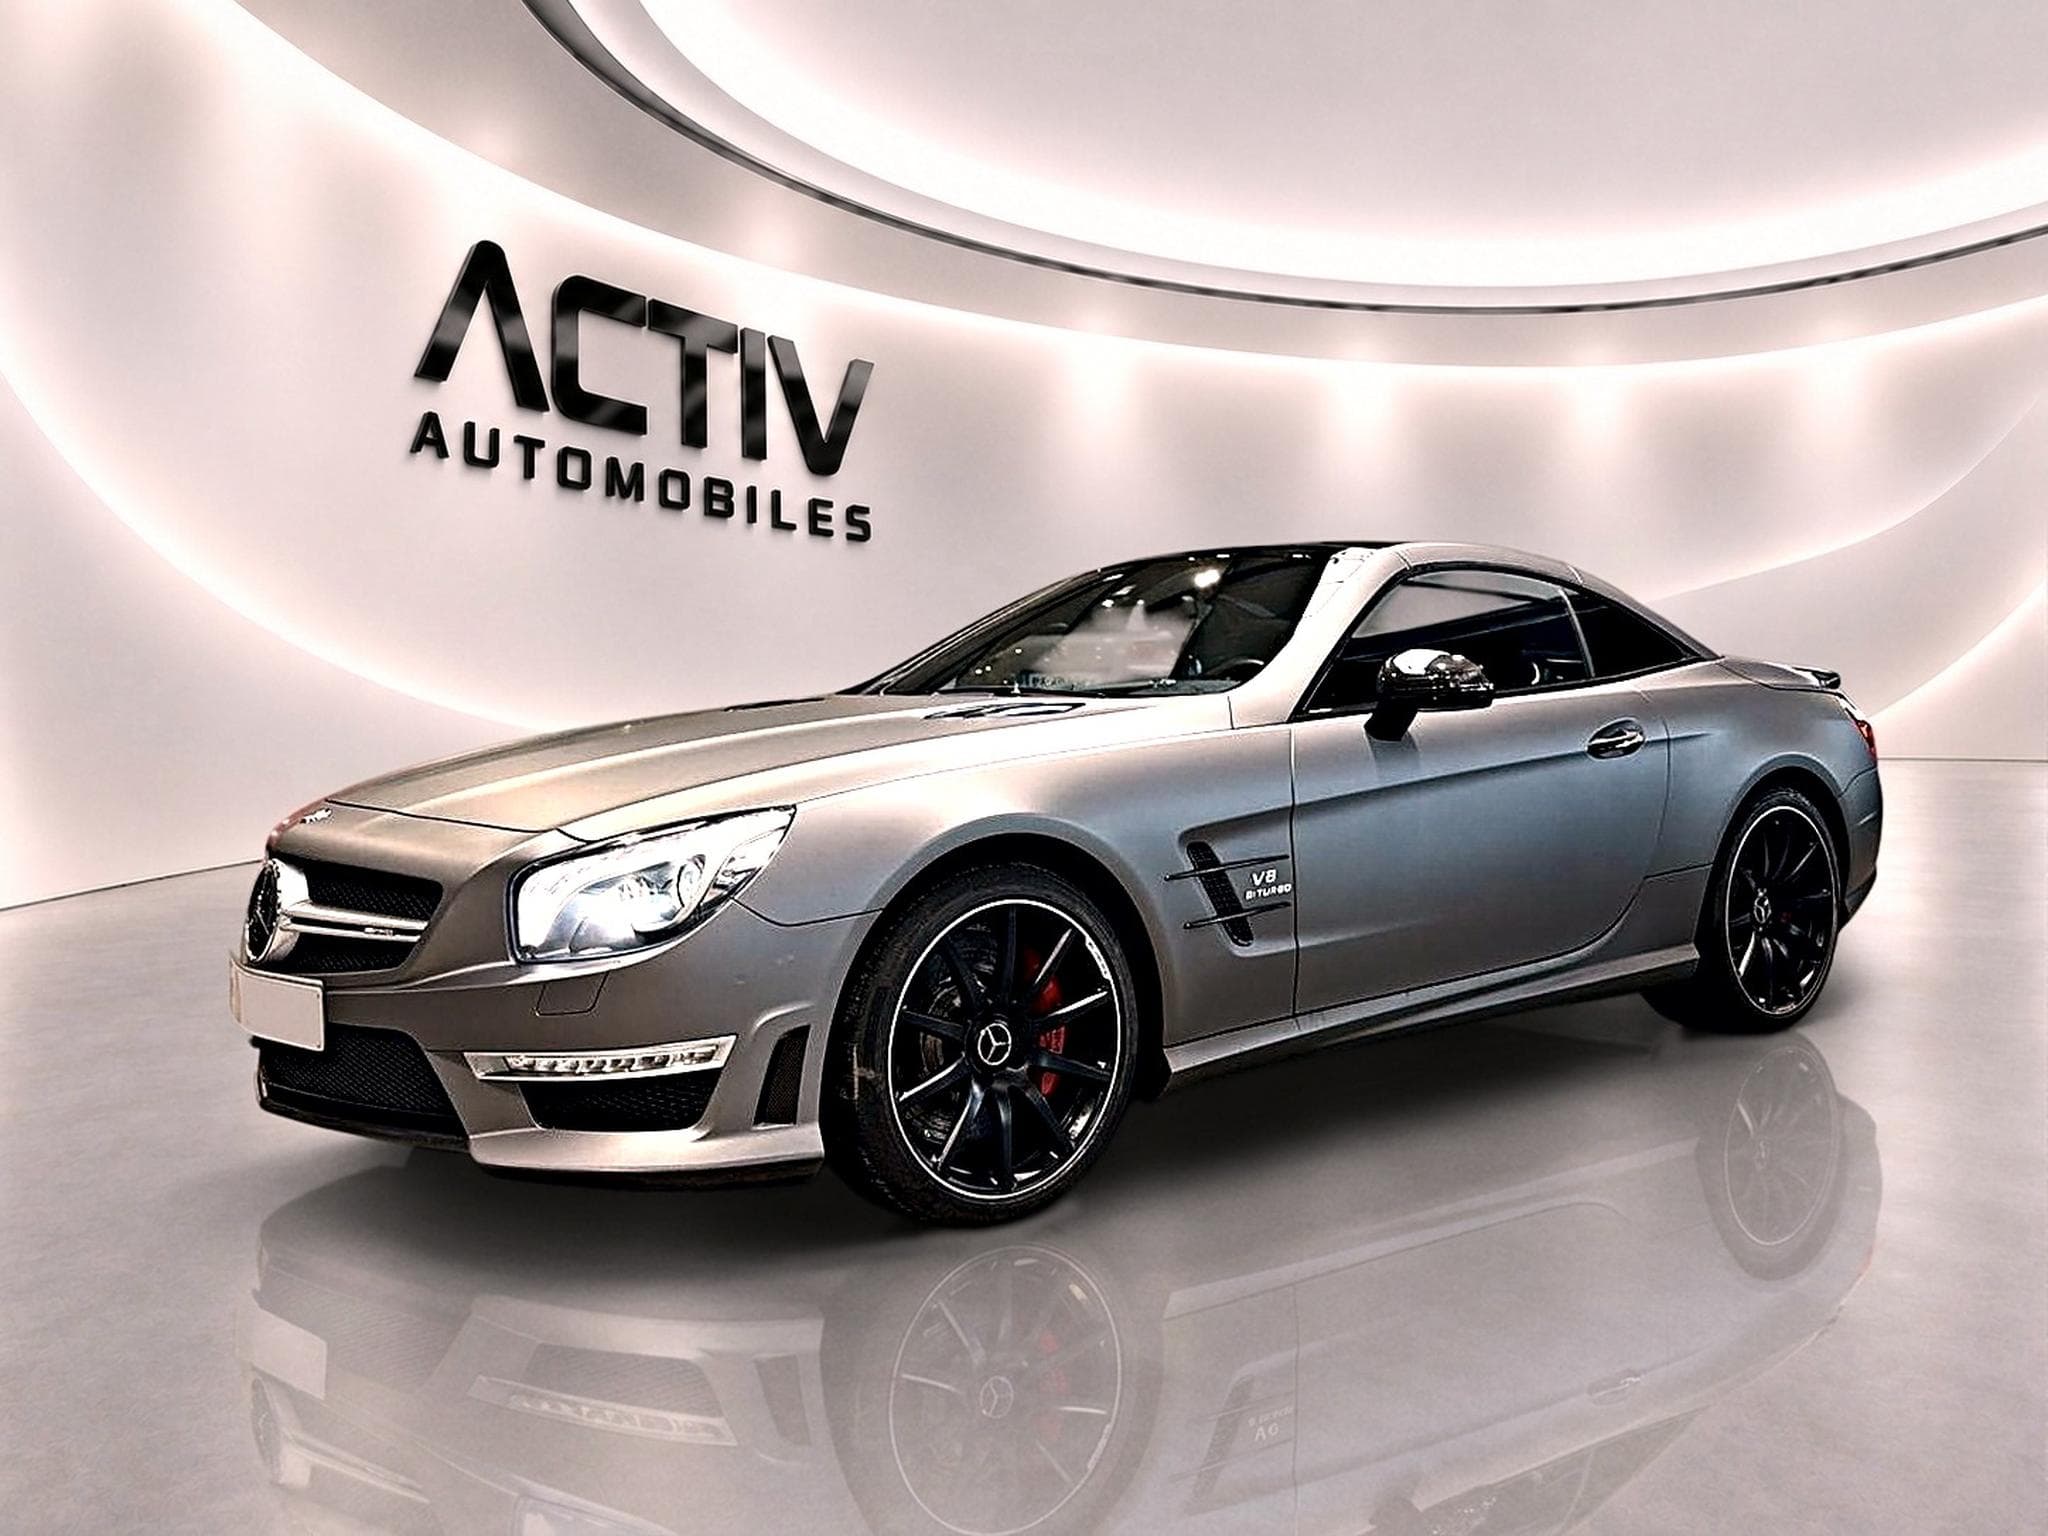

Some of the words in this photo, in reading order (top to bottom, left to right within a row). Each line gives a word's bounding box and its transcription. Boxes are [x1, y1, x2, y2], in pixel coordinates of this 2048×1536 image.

[414, 240, 875, 476] ACTIV
[410, 411, 872, 543] AUTOMOBILES
[1251, 869, 1277, 886] V8
